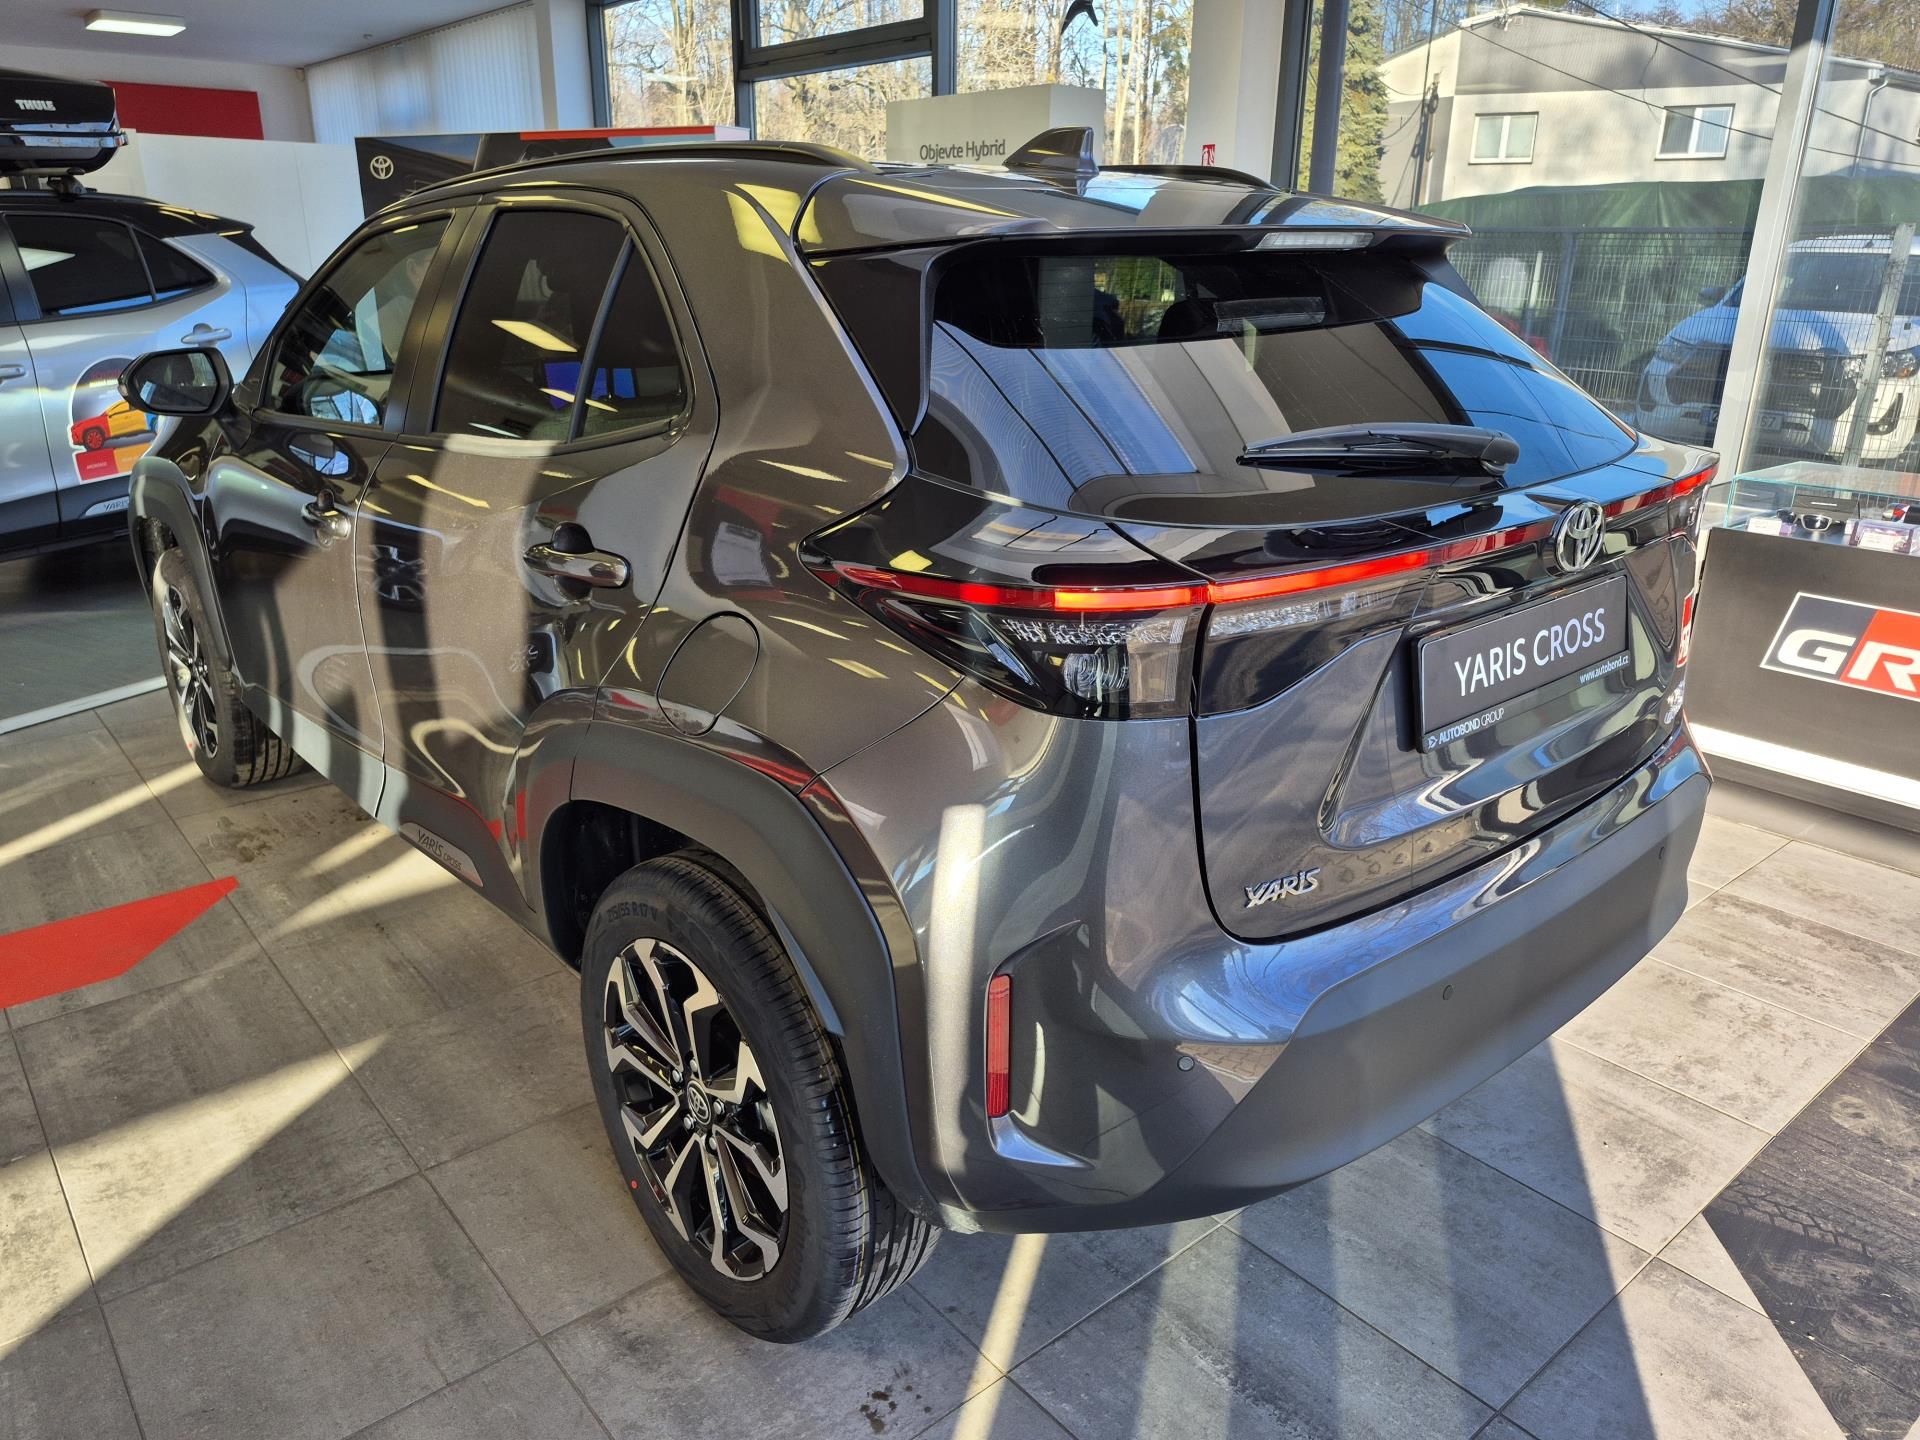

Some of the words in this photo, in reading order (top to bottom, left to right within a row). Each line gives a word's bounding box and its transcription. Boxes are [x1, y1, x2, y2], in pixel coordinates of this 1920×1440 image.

[15, 99, 56, 111] THULE
[920, 144, 963, 163] Objevte
[966, 139, 1005, 161] Hybrid
[1454, 637, 1527, 697] YARIS
[1533, 607, 1605, 667] CROSS
[1777, 629, 1920, 692] GR
[1579, 654, 1629, 685] www.autobond.cz
[1438, 716, 1480, 745] AUTOBOND
[1480, 707, 1505, 729] GROUP
[417, 827, 443, 857] YARIS
[1245, 867, 1321, 909] YARIS
